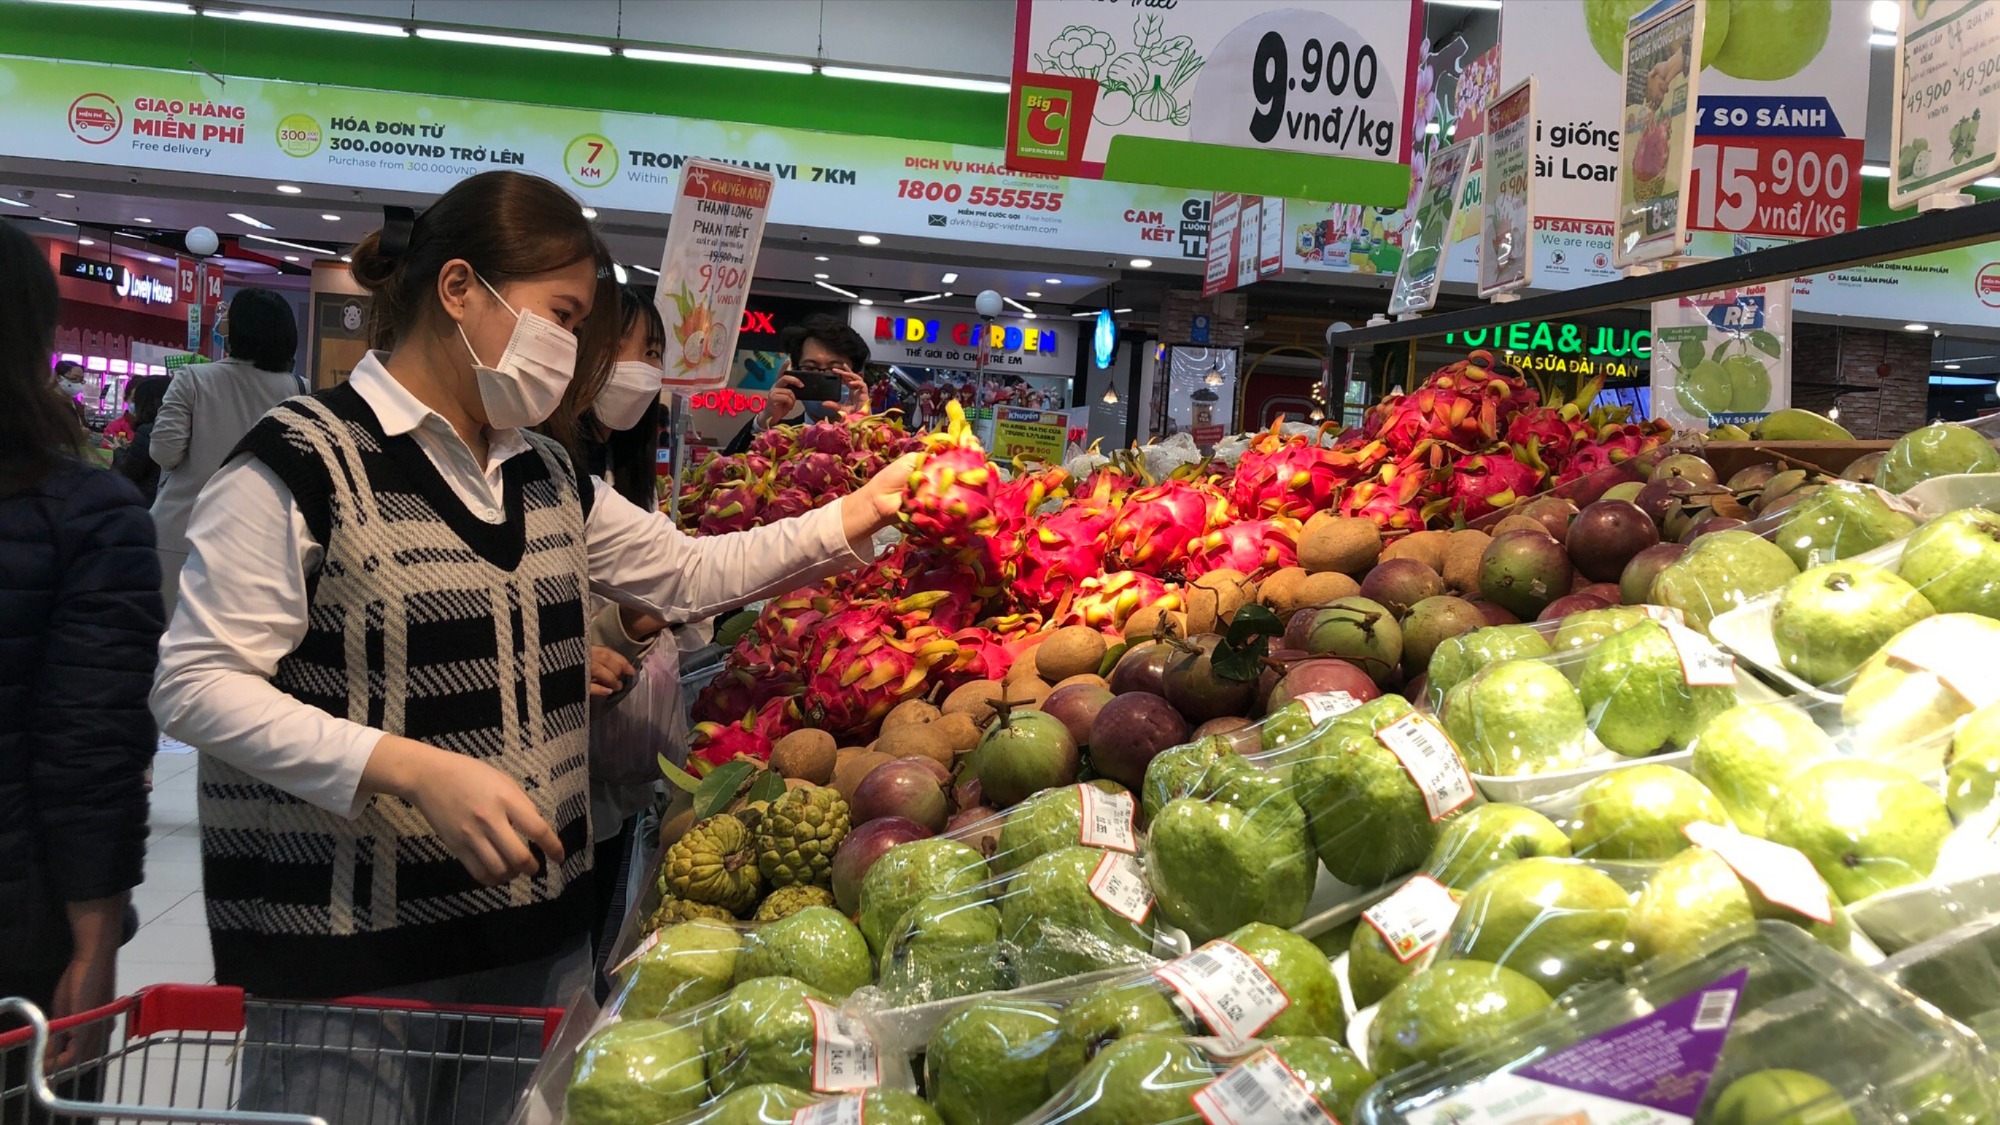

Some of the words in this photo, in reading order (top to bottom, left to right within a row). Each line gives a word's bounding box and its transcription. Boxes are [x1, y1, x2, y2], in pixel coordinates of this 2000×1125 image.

[1249, 31, 1377, 143] 9.900
[1907, 79, 1951, 113] 49.900
[134, 97, 184, 115] GIAO
[188, 100, 246, 120] HÀNG
[1026, 95, 1051, 111] Big
[1027, 97, 1070, 146] C
[1713, 107, 1748, 127] SO
[1756, 104, 1826, 127] SÁNH
[133, 113, 196, 140] MIỄN
[202, 123, 246, 145] PHÍ
[281, 130, 306, 141] 300
[330, 116, 371, 133] HÓA
[375, 120, 413, 136] ĐƠN
[419, 124, 446, 139] TỪ
[1286, 105, 1394, 156] vnđ/kg
[132, 140, 159, 151] Free
[163, 142, 212, 157] delivery
[330, 137, 446, 158] 300.000VNĐ
[450, 144, 487, 162] TRỞ
[490, 149, 525, 165] LÊN
[587, 142, 604, 164] 7
[1020, 146, 1065, 157] SUPERCENTER
[328, 155, 376, 168] Purchase
[380, 160, 405, 170] from
[580, 167, 601, 179] KM
[905, 156, 939, 171] DỊCH
[943, 161, 963, 175] VỤ
[966, 162, 1016, 177] KHÁCH
[627, 170, 669, 185] Within
[776, 163, 797, 180] VI
[811, 165, 857, 186] 7KM
[1002, 179, 1035, 189] Customer
[1036, 182, 1060, 190] service
[897, 179, 962, 203] 1800
[967, 186, 1064, 212] 555555
[1691, 143, 1849, 231] 15.900
[697, 200, 730, 216] THANH
[731, 206, 754, 220] LONG
[1123, 209, 1164, 225] CAM
[1758, 200, 1847, 235] vnđ/KG
[693, 220, 722, 237] PHAN
[724, 222, 750, 239] THIẾT
[950, 217, 1058, 234] dvkh@bigc-vietnam.com
[1141, 224, 1176, 242] KẾT
[1182, 221, 1207, 231] LUÔN
[1541, 233, 1560, 245] We
[1563, 236, 1583, 247] are
[1585, 238, 1614, 250] read
[130, 274, 153, 304] Lovely
[152, 278, 173, 304] House
[181, 269, 193, 293] 13
[208, 276, 221, 298] 14
[1746, 285, 1766, 295] luôn
[1723, 298, 1758, 326] RẺ
[874, 316, 940, 344] KIDS
[905, 347, 922, 358] THẾ
[1008, 356, 1023, 365] EM
[1504, 352, 1533, 370] TRÀ
[1535, 354, 1567, 372] SỮA
[1569, 358, 1594, 374] ĐÀI
[690, 388, 768, 417] SOXBO
[1008, 411, 1038, 421] Khuyến
[1734, 416, 1746, 424] SO
